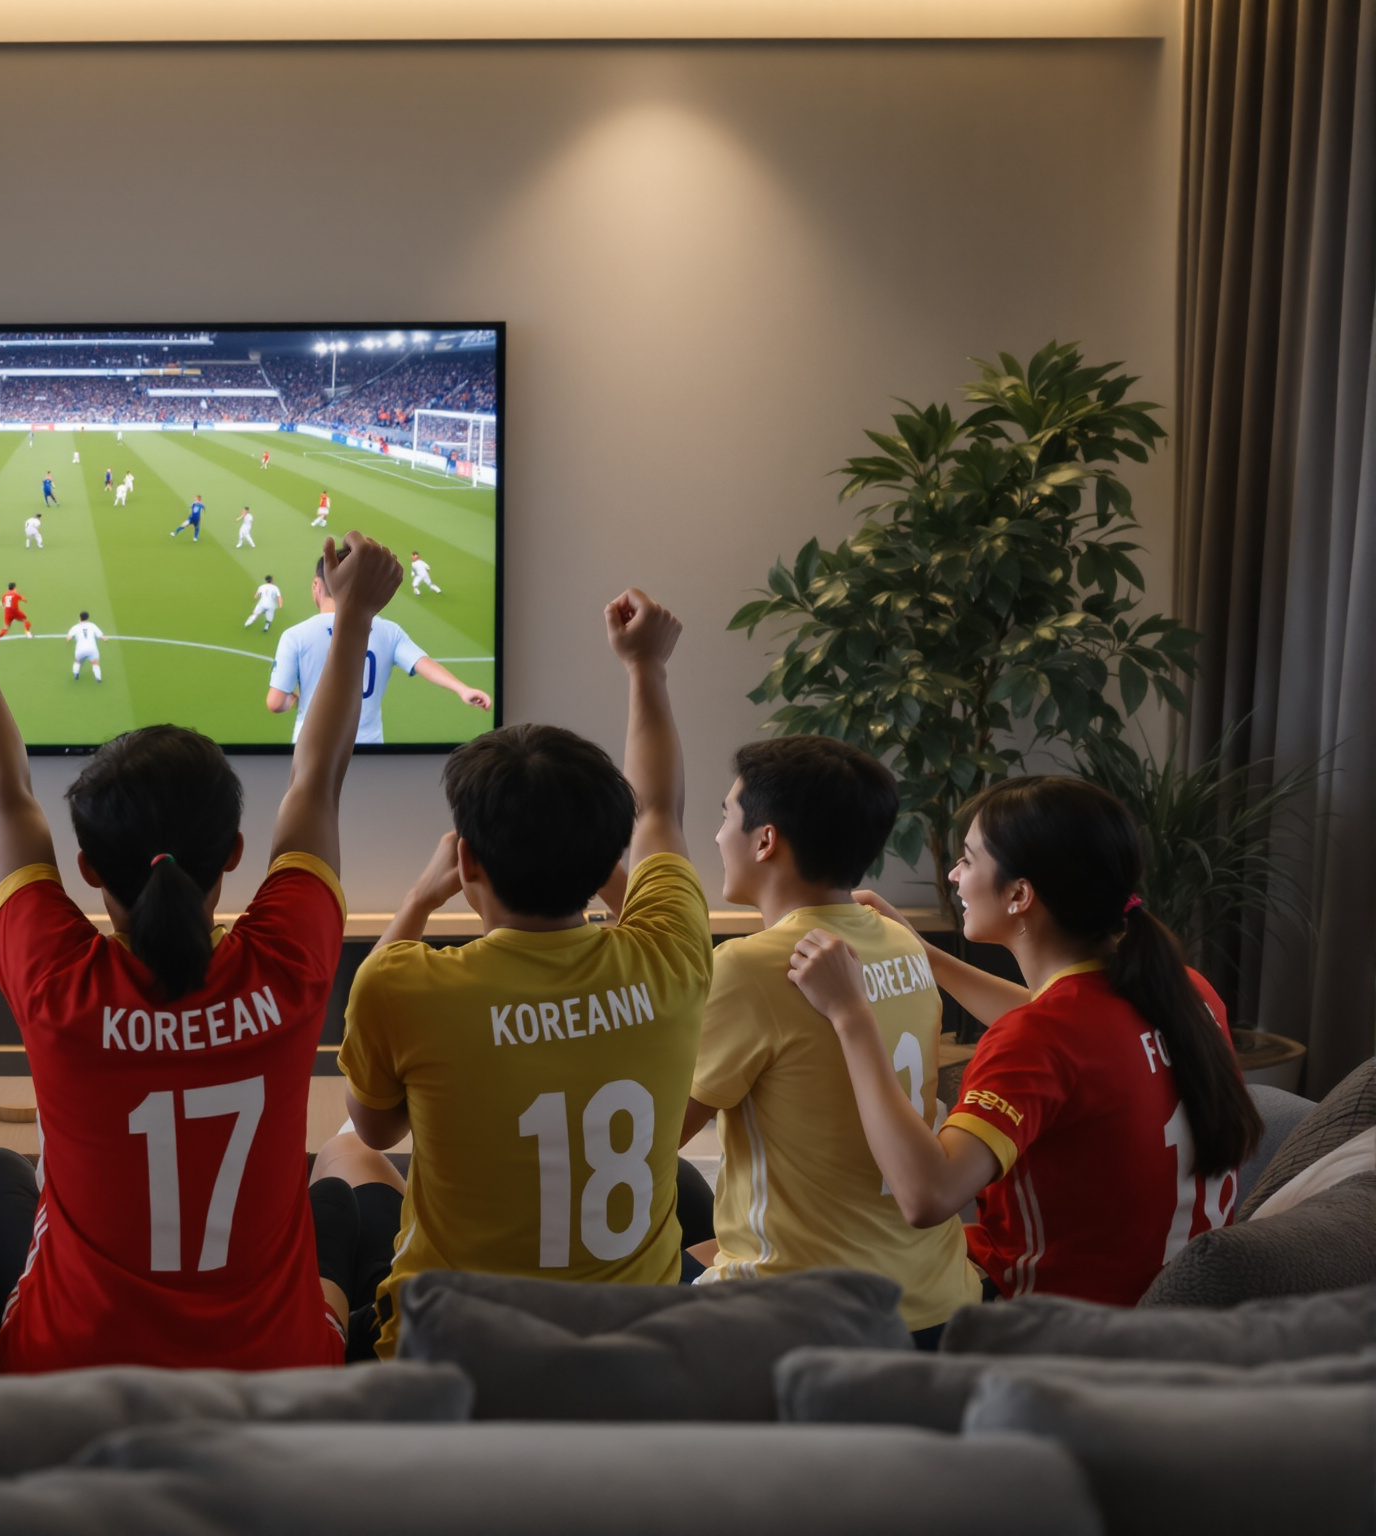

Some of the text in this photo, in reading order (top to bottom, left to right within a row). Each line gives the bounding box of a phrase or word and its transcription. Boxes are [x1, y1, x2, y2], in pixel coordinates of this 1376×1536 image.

[102, 985, 283, 1053] KOREEAN
[489, 982, 655, 1047] KOREANN
[127, 1074, 266, 1273] 17
[518, 1079, 655, 1269] 18
